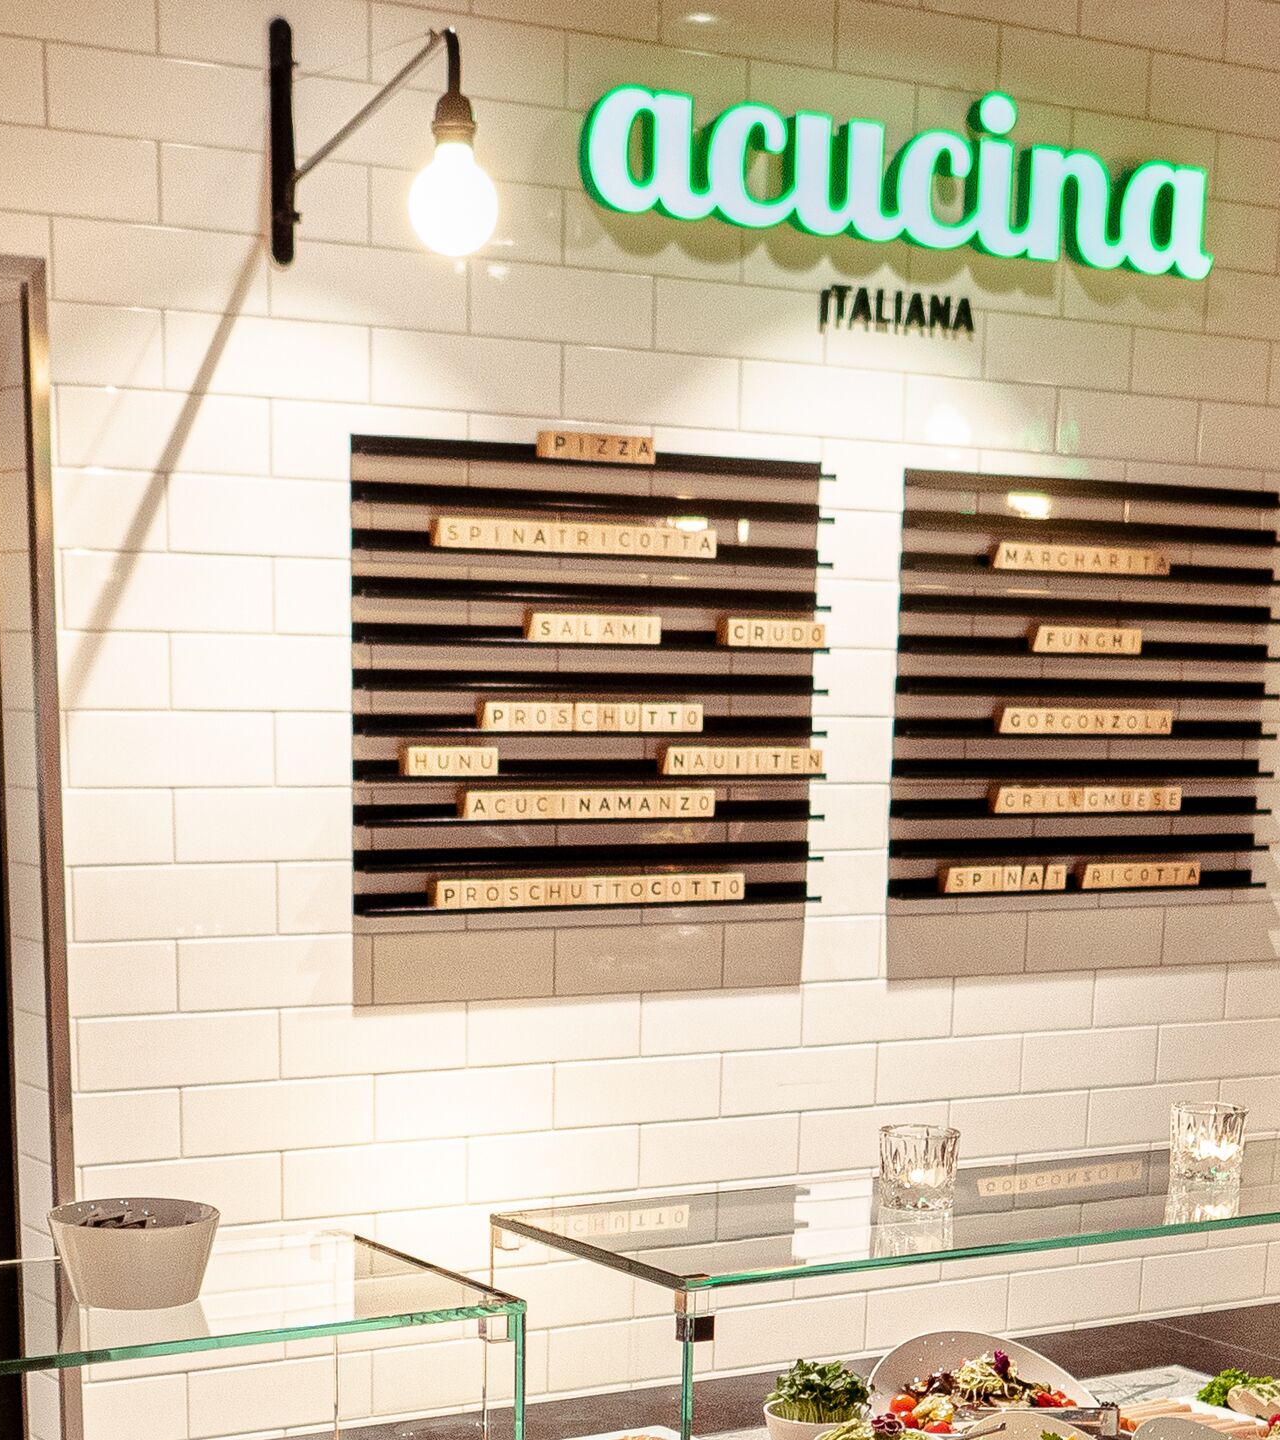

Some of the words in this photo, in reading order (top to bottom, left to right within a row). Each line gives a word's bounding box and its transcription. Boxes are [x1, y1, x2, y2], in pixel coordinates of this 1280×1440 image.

[583, 83, 1215, 281] acucina
[819, 285, 975, 334] ITALIANA
[554, 434, 651, 456] PIZZA
[446, 524, 712, 552] SPINATRICOTTA
[1004, 548, 1168, 571] MARGHARITA
[540, 620, 653, 639] SALAMI
[733, 624, 822, 642] CRUDO
[1045, 632, 1137, 648] FUNGHI
[492, 708, 699, 727] PROSCHUTTO
[1010, 713, 1170, 730] GORGONZOLA
[414, 754, 494, 770] HUNU
[473, 796, 710, 815] ACUCINAMANZO
[954, 870, 1062, 888] SPINAT
[1092, 867, 1197, 883] RICOTTA
[443, 879, 740, 903] PROSCHUTTOCOTTO
